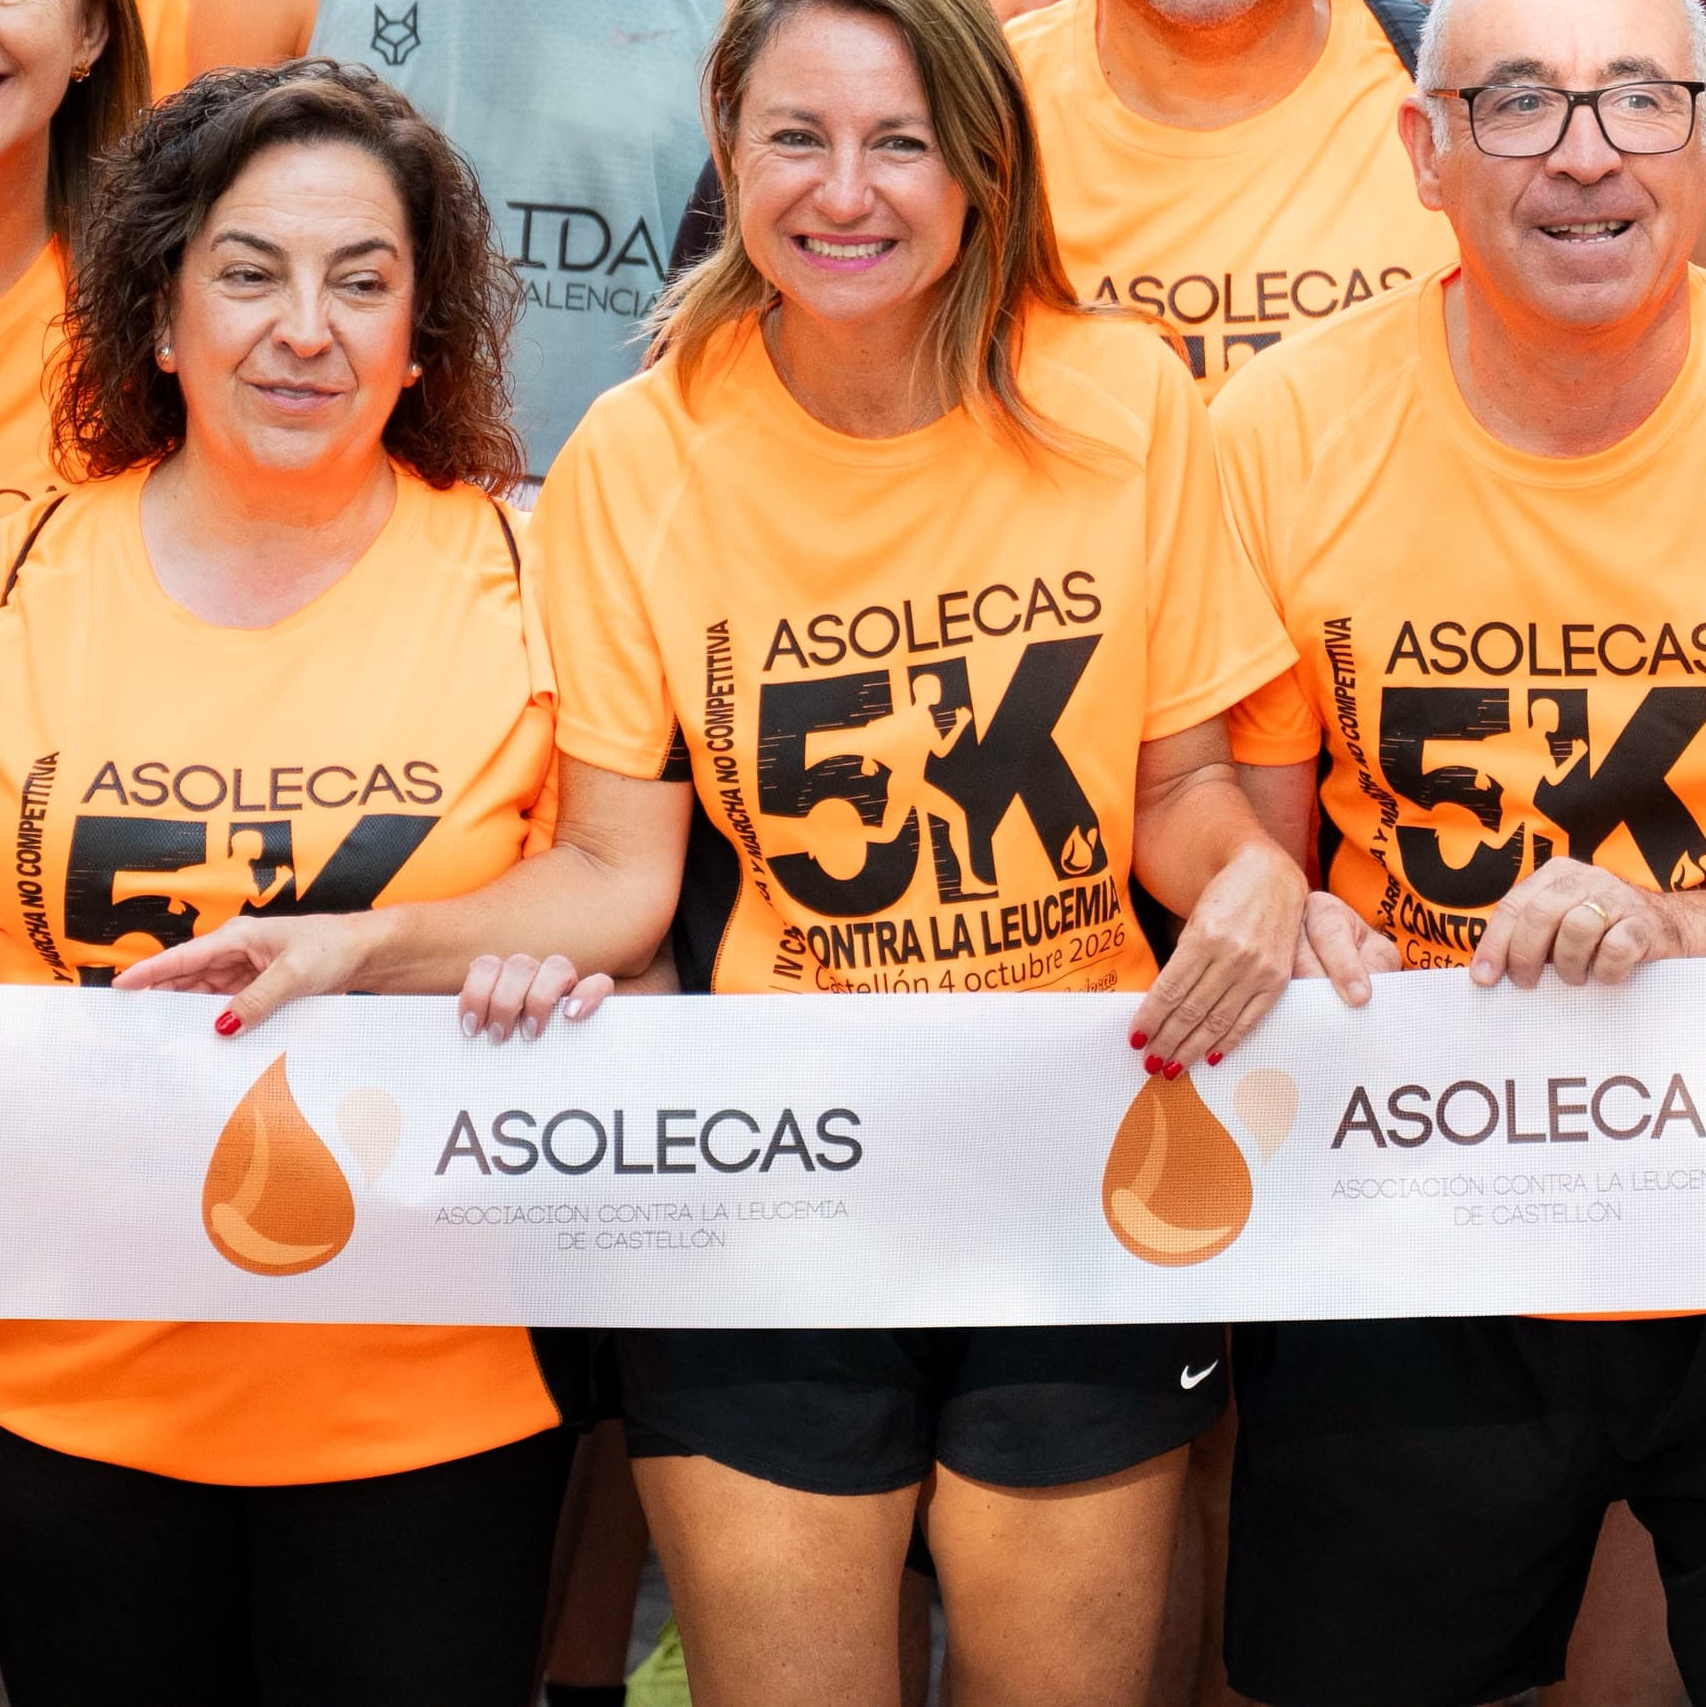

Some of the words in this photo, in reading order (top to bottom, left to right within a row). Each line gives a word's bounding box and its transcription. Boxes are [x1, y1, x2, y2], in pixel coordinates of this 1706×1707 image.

[519, 279, 659, 317] ALENCIA
[762, 570, 1102, 672] ASOLECAS
[704, 618, 735, 753] COMPETITIVA
[1323, 616, 1361, 742] COMPETITIVA
[80, 760, 444, 813] ASOLECAS
[715, 754, 740, 786] NO
[756, 633, 1109, 919] 5K
[15, 750, 61, 878] COMPETITIVA
[719, 787, 762, 861] MARCHA
[20, 877, 45, 910] NO
[807, 917, 925, 971] ONTRA
[929, 912, 976, 961] LA
[980, 874, 1122, 955] LEUCEMIA
[21, 910, 67, 973] MARCHA
[772, 954, 804, 981] IV
[937, 969, 955, 994] 4
[963, 945, 1064, 993] octubre
[1068, 921, 1127, 964] 2026
[53, 967, 74, 984] Y
[434, 1108, 863, 1176] ASOLECAS
[434, 1203, 589, 1225] ASOCIACIÓN
[597, 1203, 694, 1224] CONTRA
[702, 1202, 729, 1221] LA
[737, 1199, 850, 1222] LEUCEMIA
[1331, 1174, 1484, 1200] ASOCIACIÓN
[1492, 1172, 1588, 1196] CONTRA
[1596, 1172, 1625, 1193] LA
[557, 1230, 587, 1251] DE
[1453, 1205, 1484, 1227] DE
